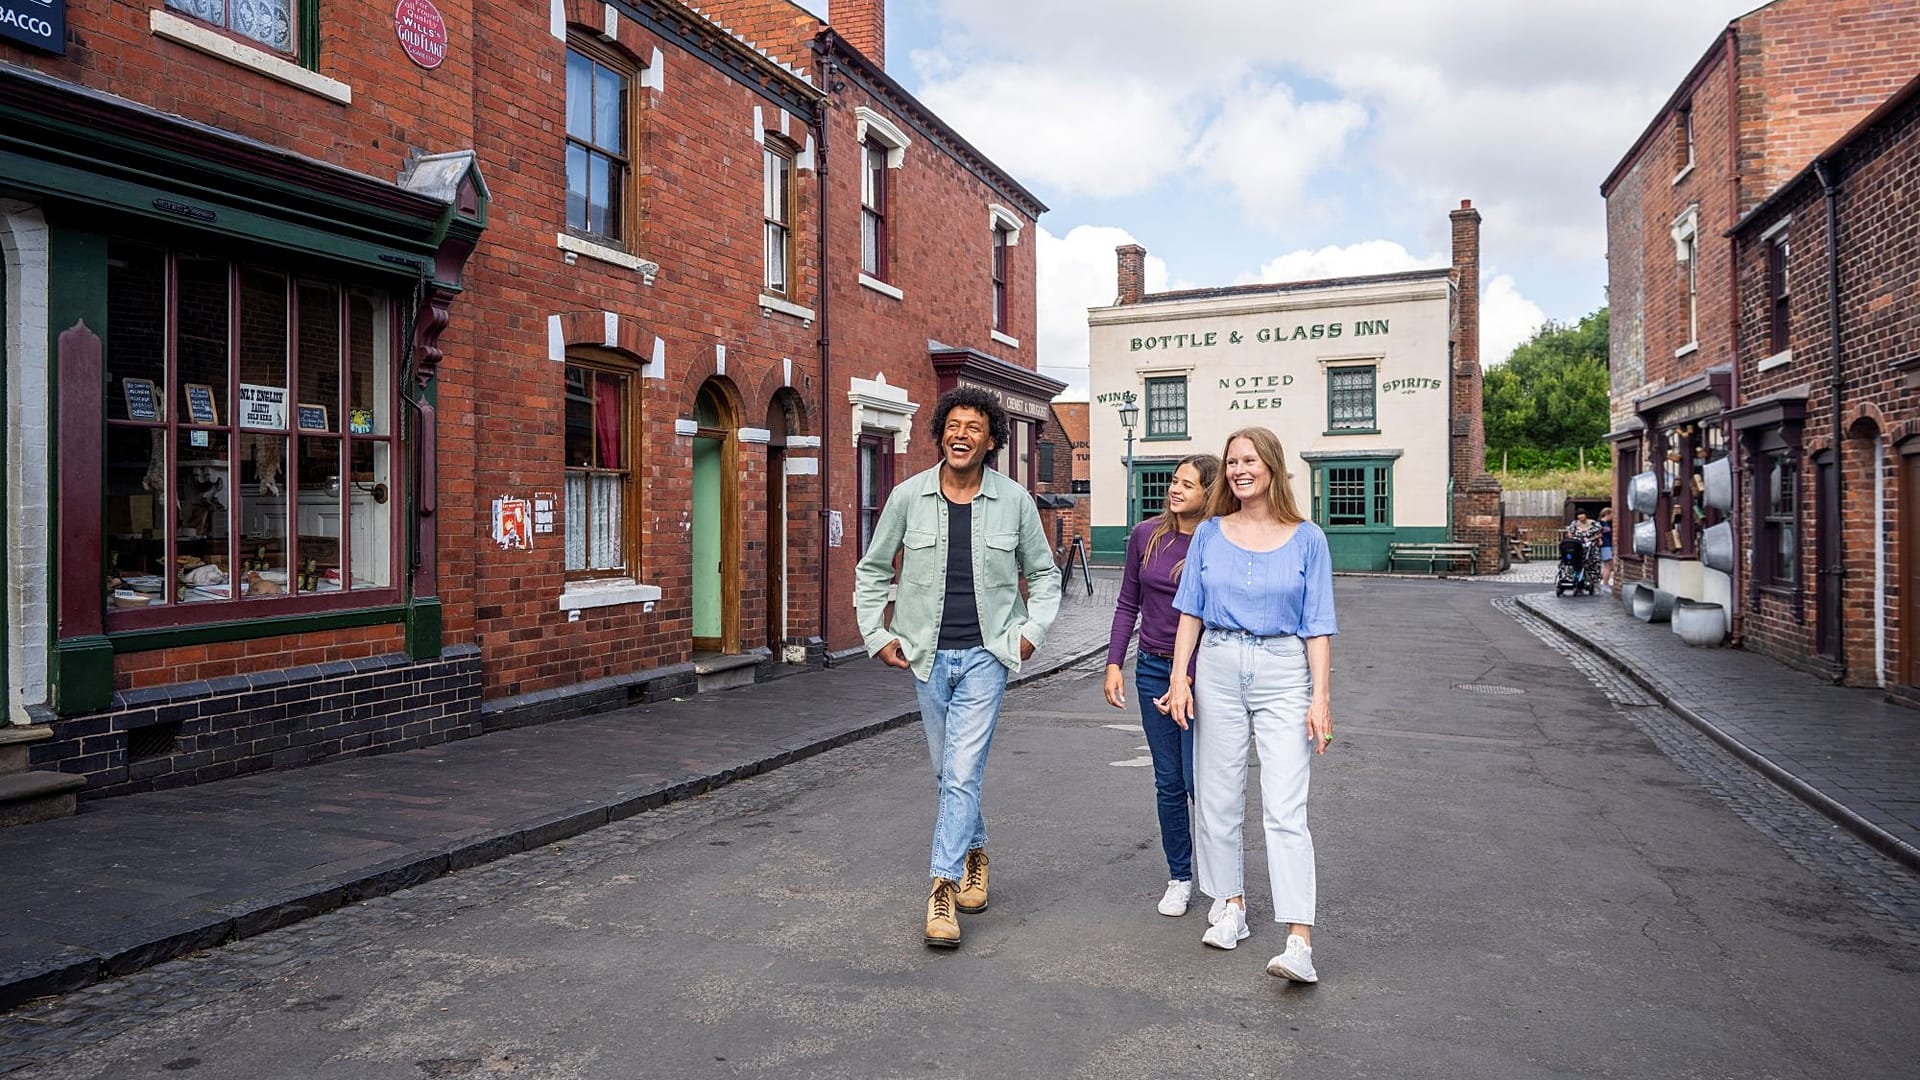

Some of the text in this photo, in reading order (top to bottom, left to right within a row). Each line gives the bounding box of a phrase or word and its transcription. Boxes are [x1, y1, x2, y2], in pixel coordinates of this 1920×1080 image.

[407, 9, 438, 29] Quality
[398, 24, 446, 58] GOLD FLAKE
[1130, 319, 1390, 352] BOTTLE & GLASS INN
[1218, 374, 1294, 389] NOTED
[1382, 376, 1442, 393] SPIRITS
[240, 388, 255, 401] NLY
[1229, 397, 1283, 410] ALES
